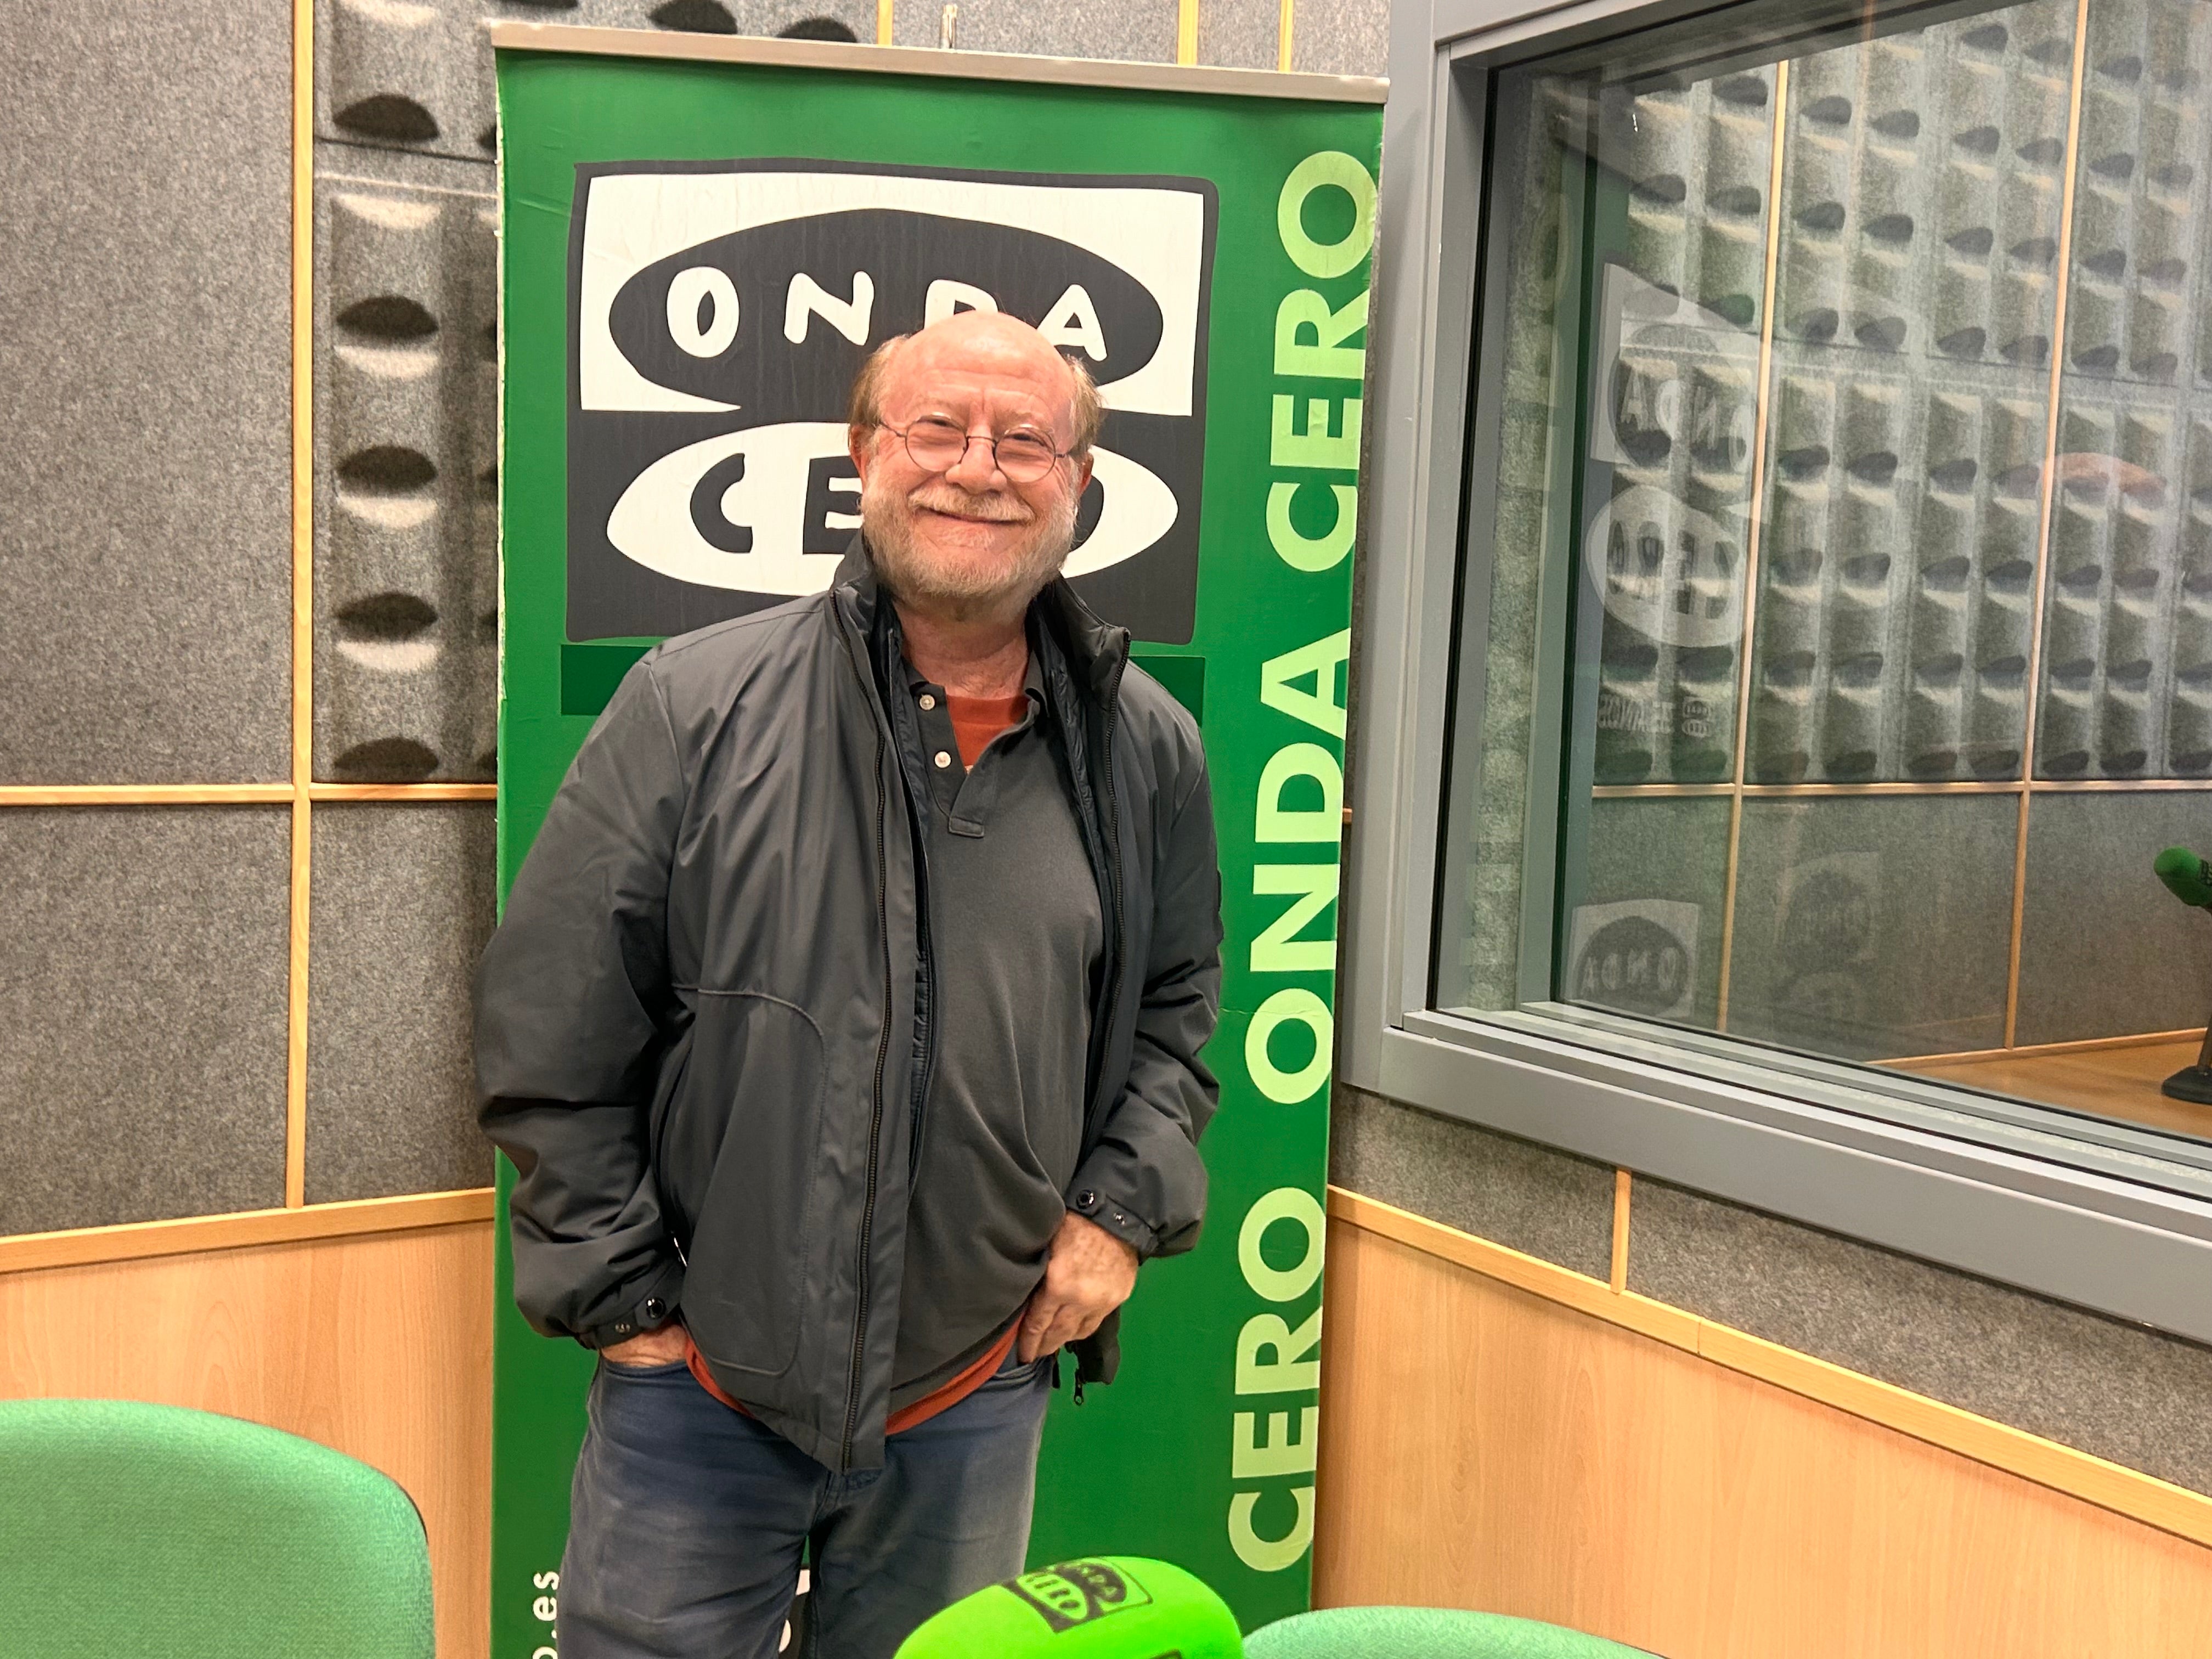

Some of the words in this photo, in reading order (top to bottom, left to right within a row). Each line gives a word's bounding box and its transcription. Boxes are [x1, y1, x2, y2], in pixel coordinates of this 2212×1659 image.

[1265, 150, 1378, 572] CERO
[1244, 627, 1352, 1104] ONDA
[1228, 1186, 1327, 1572] CERO
